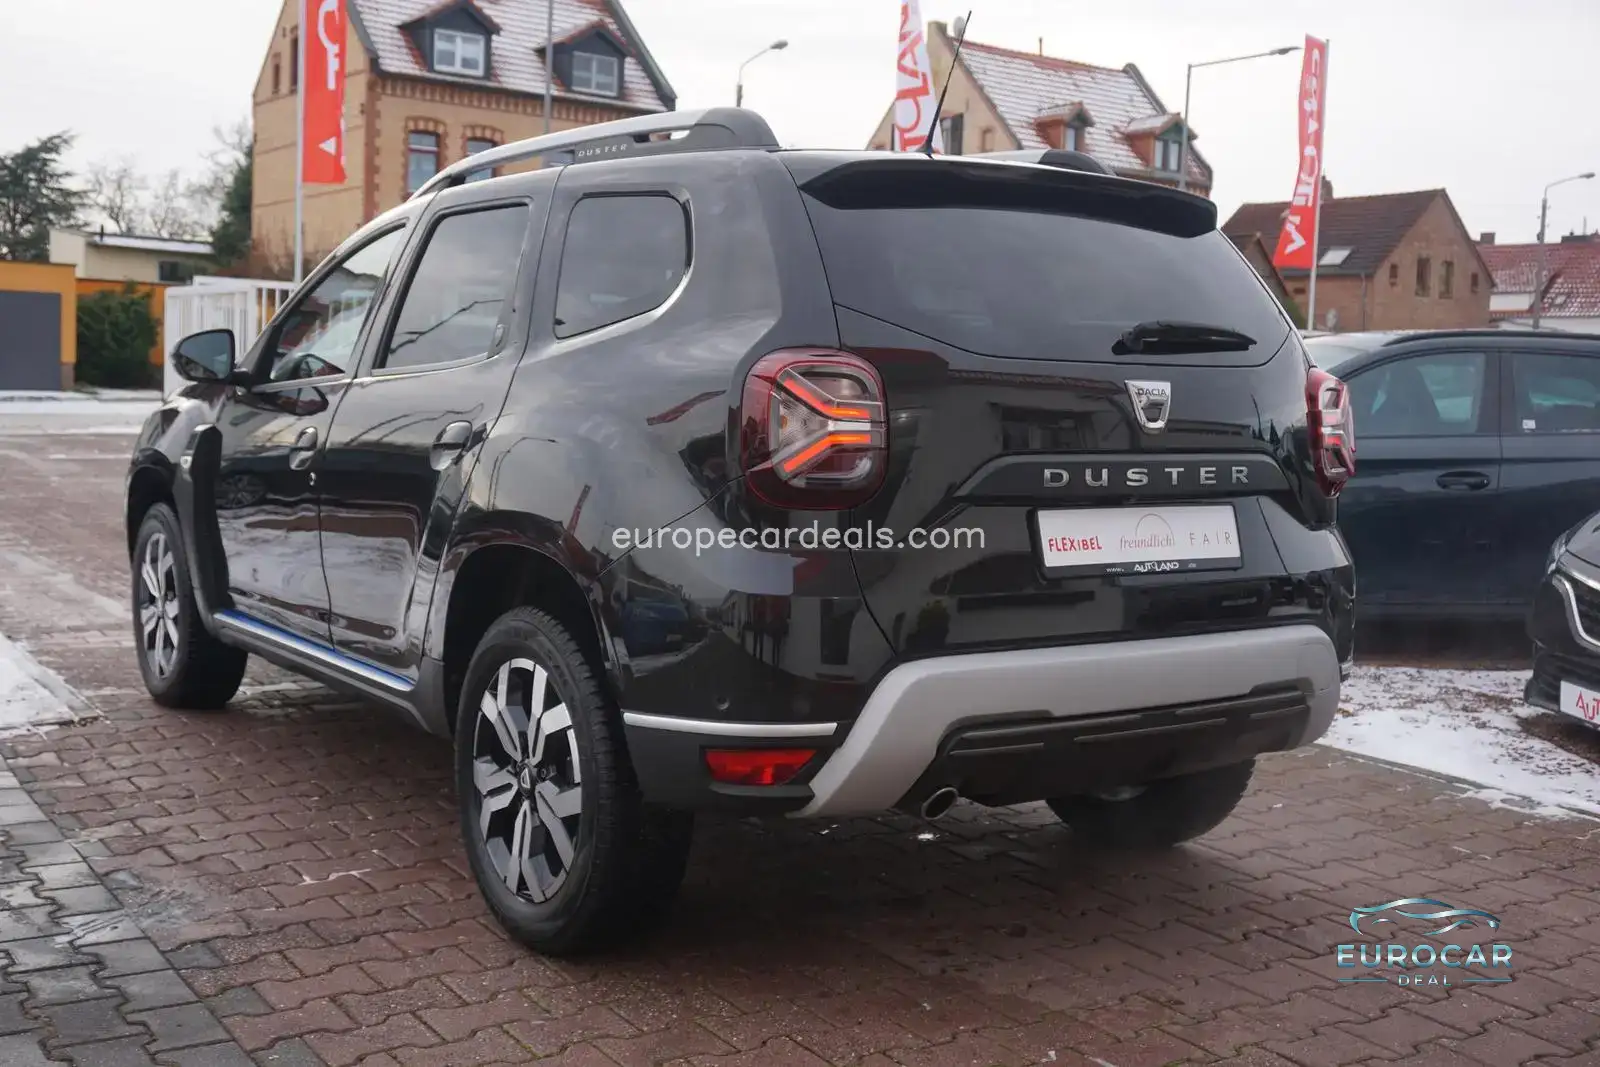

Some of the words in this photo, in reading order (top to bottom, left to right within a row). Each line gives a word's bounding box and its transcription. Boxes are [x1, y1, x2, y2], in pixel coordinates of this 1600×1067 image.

[578, 143, 628, 157] DUSTER
[1137, 388, 1167, 396] DACIA
[1043, 466, 1249, 487] DUSTER
[1120, 534, 1172, 551] freundlich
[1134, 561, 1180, 572] AUTOLAND
